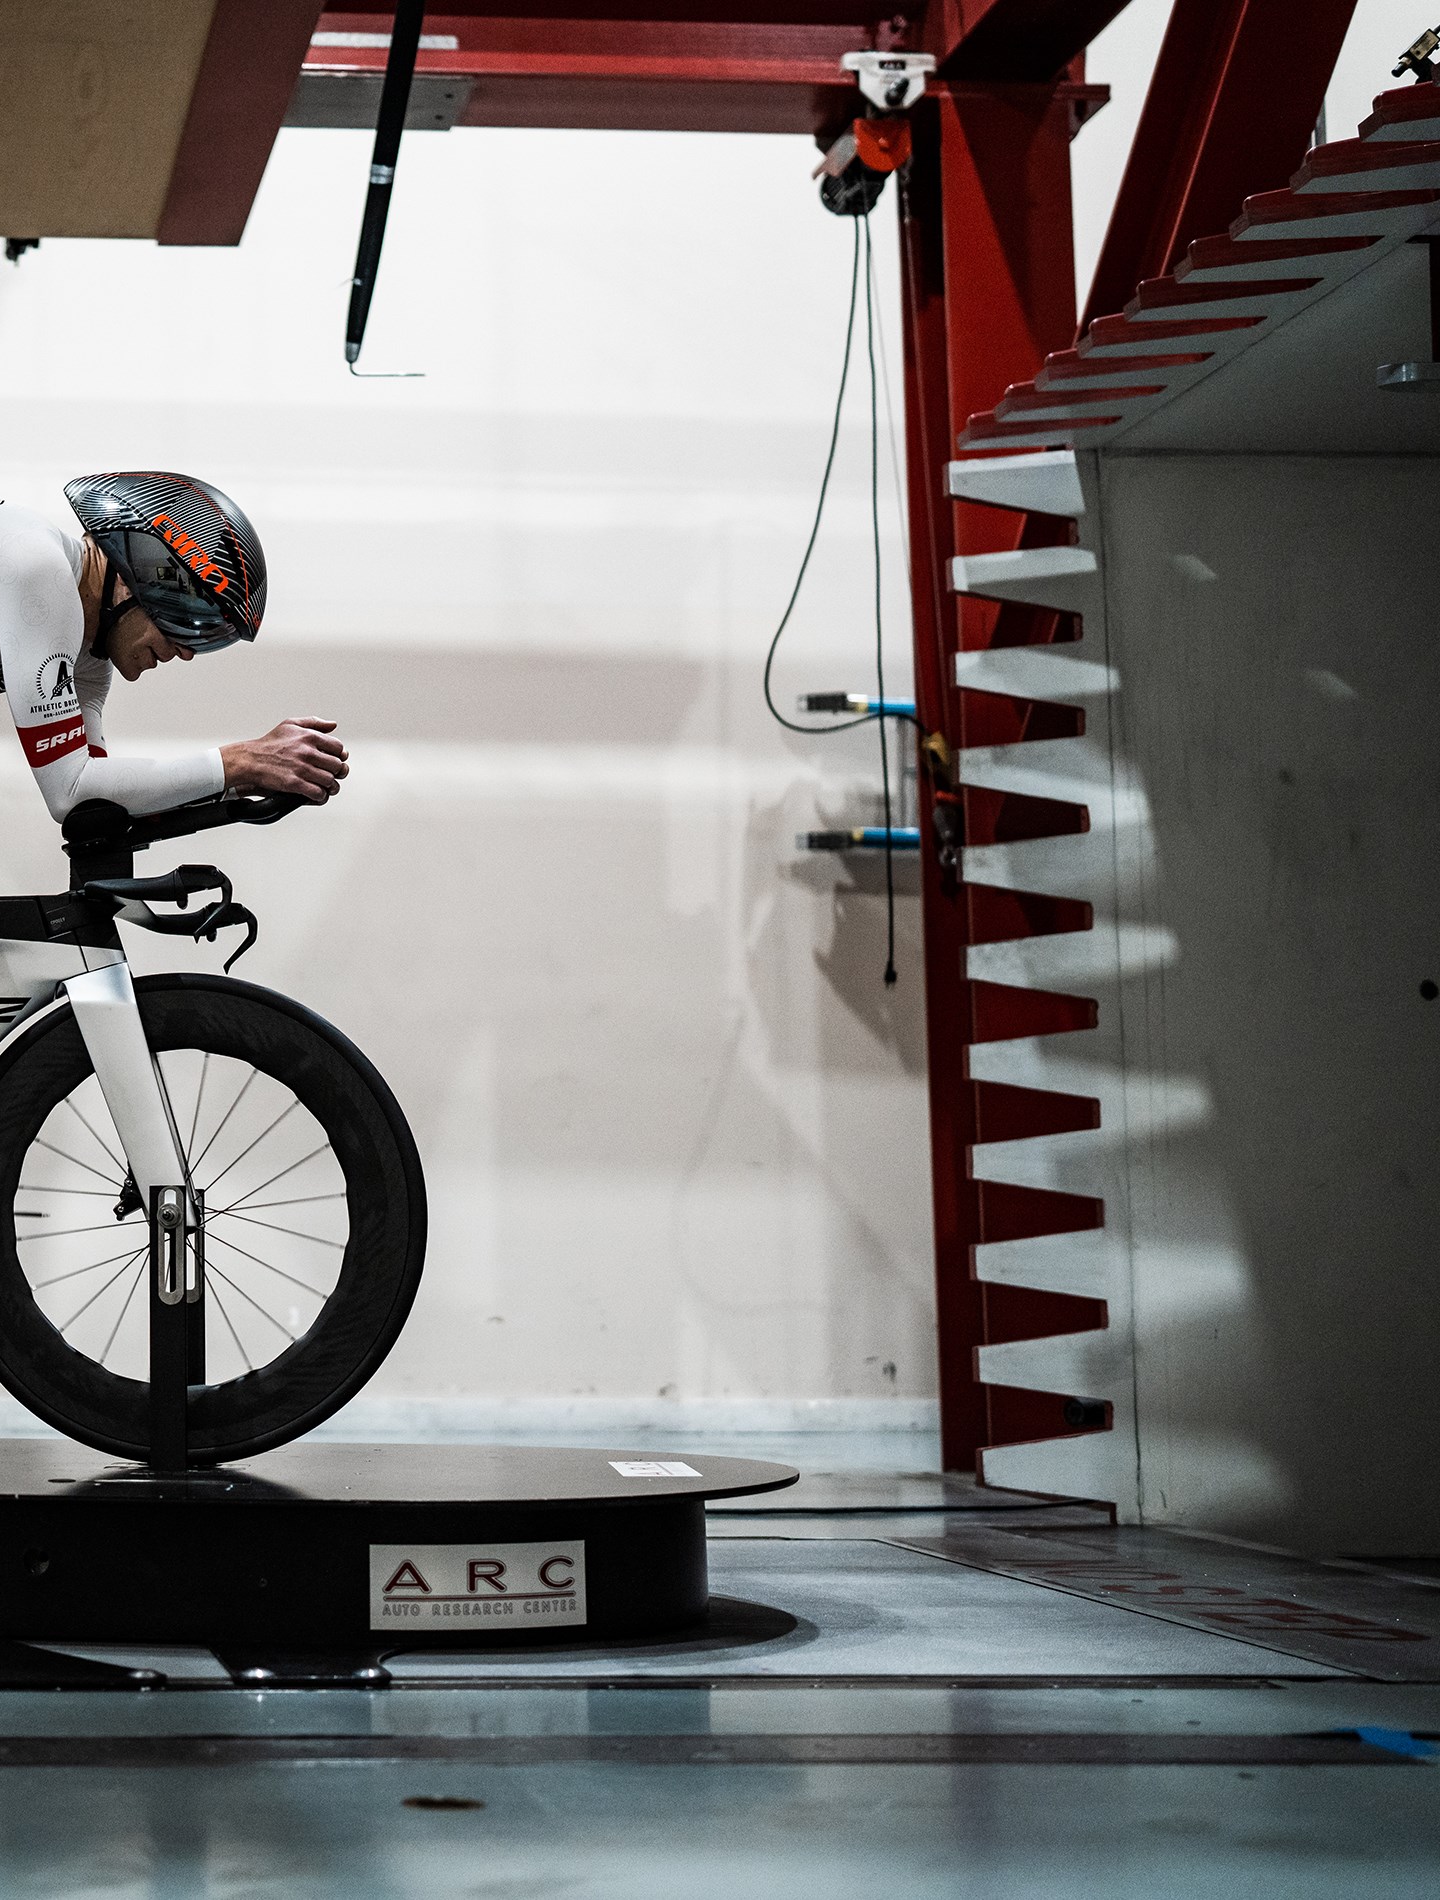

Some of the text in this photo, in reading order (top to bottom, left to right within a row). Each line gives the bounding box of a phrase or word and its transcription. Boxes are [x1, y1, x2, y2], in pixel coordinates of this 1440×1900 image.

[151, 513, 229, 594] GIRO
[30, 702, 62, 714] ATHLETIC
[382, 1599, 577, 1617] AUTO RESEARCH CENTER
